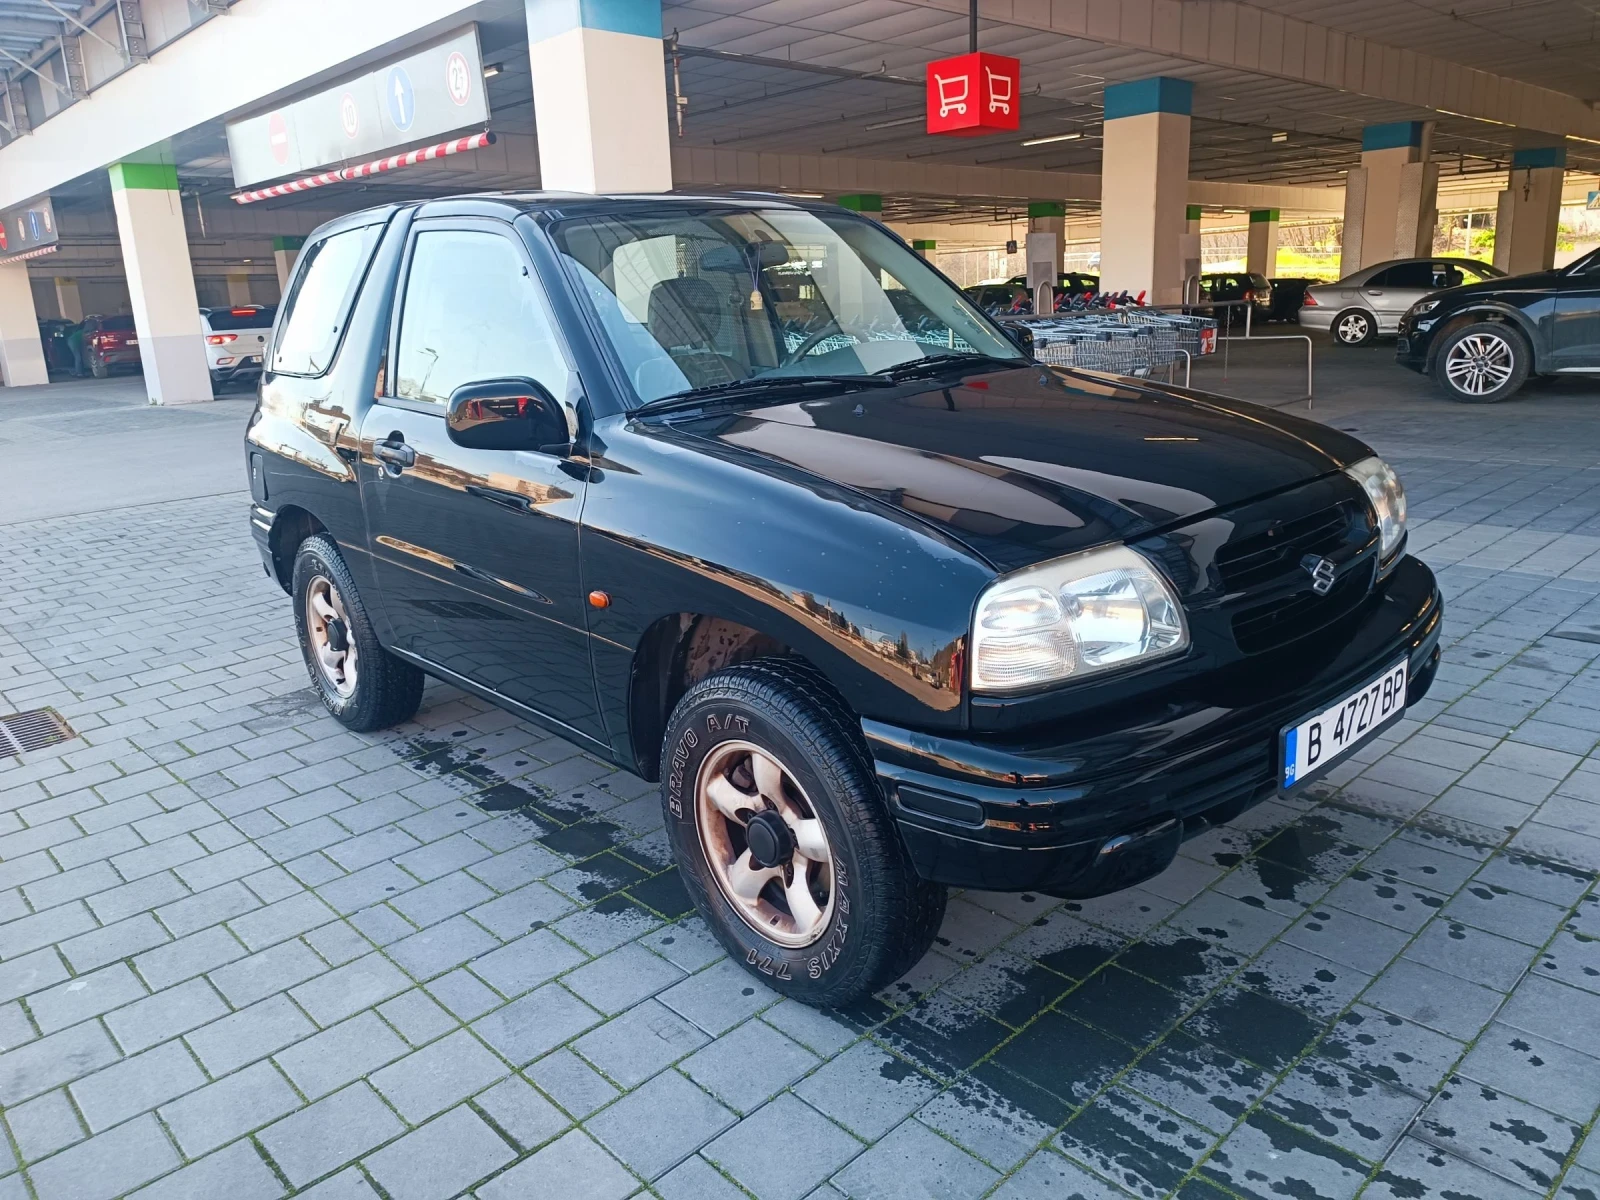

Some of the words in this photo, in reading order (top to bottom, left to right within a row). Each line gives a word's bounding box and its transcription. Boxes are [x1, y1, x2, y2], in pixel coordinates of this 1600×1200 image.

[345, 104, 355, 127] 10
[669, 728, 698, 819] BRAVO
[706, 713, 750, 734] A/T
[1307, 721, 1322, 767] B
[1333, 683, 1381, 746] 4727
[1381, 667, 1404, 716] BP
[746, 948, 792, 981] 771
[809, 856, 850, 979] MAXXIS
